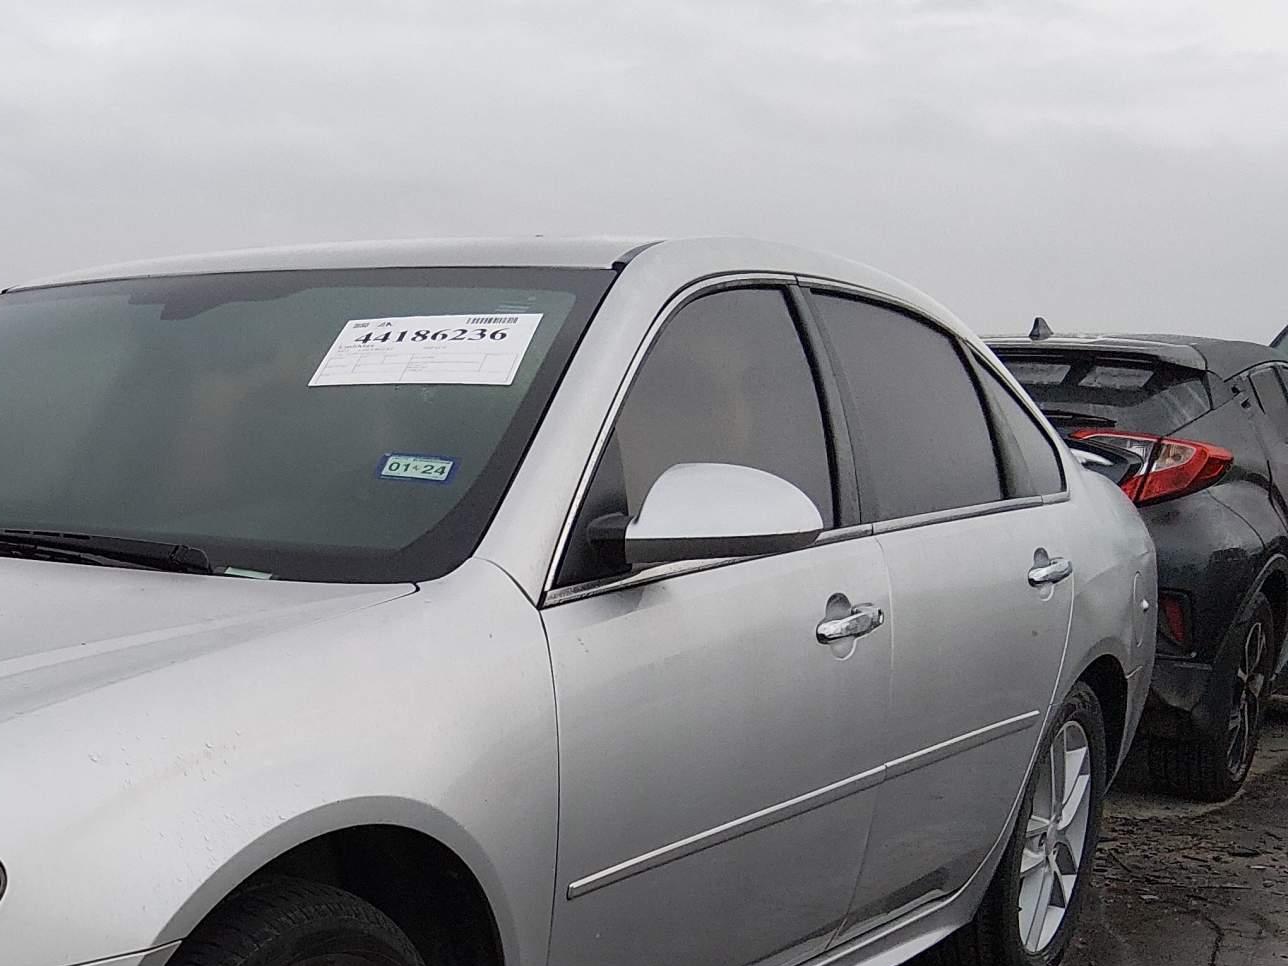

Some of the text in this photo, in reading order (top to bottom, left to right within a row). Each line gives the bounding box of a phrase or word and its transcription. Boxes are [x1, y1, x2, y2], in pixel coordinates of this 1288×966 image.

[354, 328, 509, 344] 44186236
[388, 461, 447, 475] 01 24
